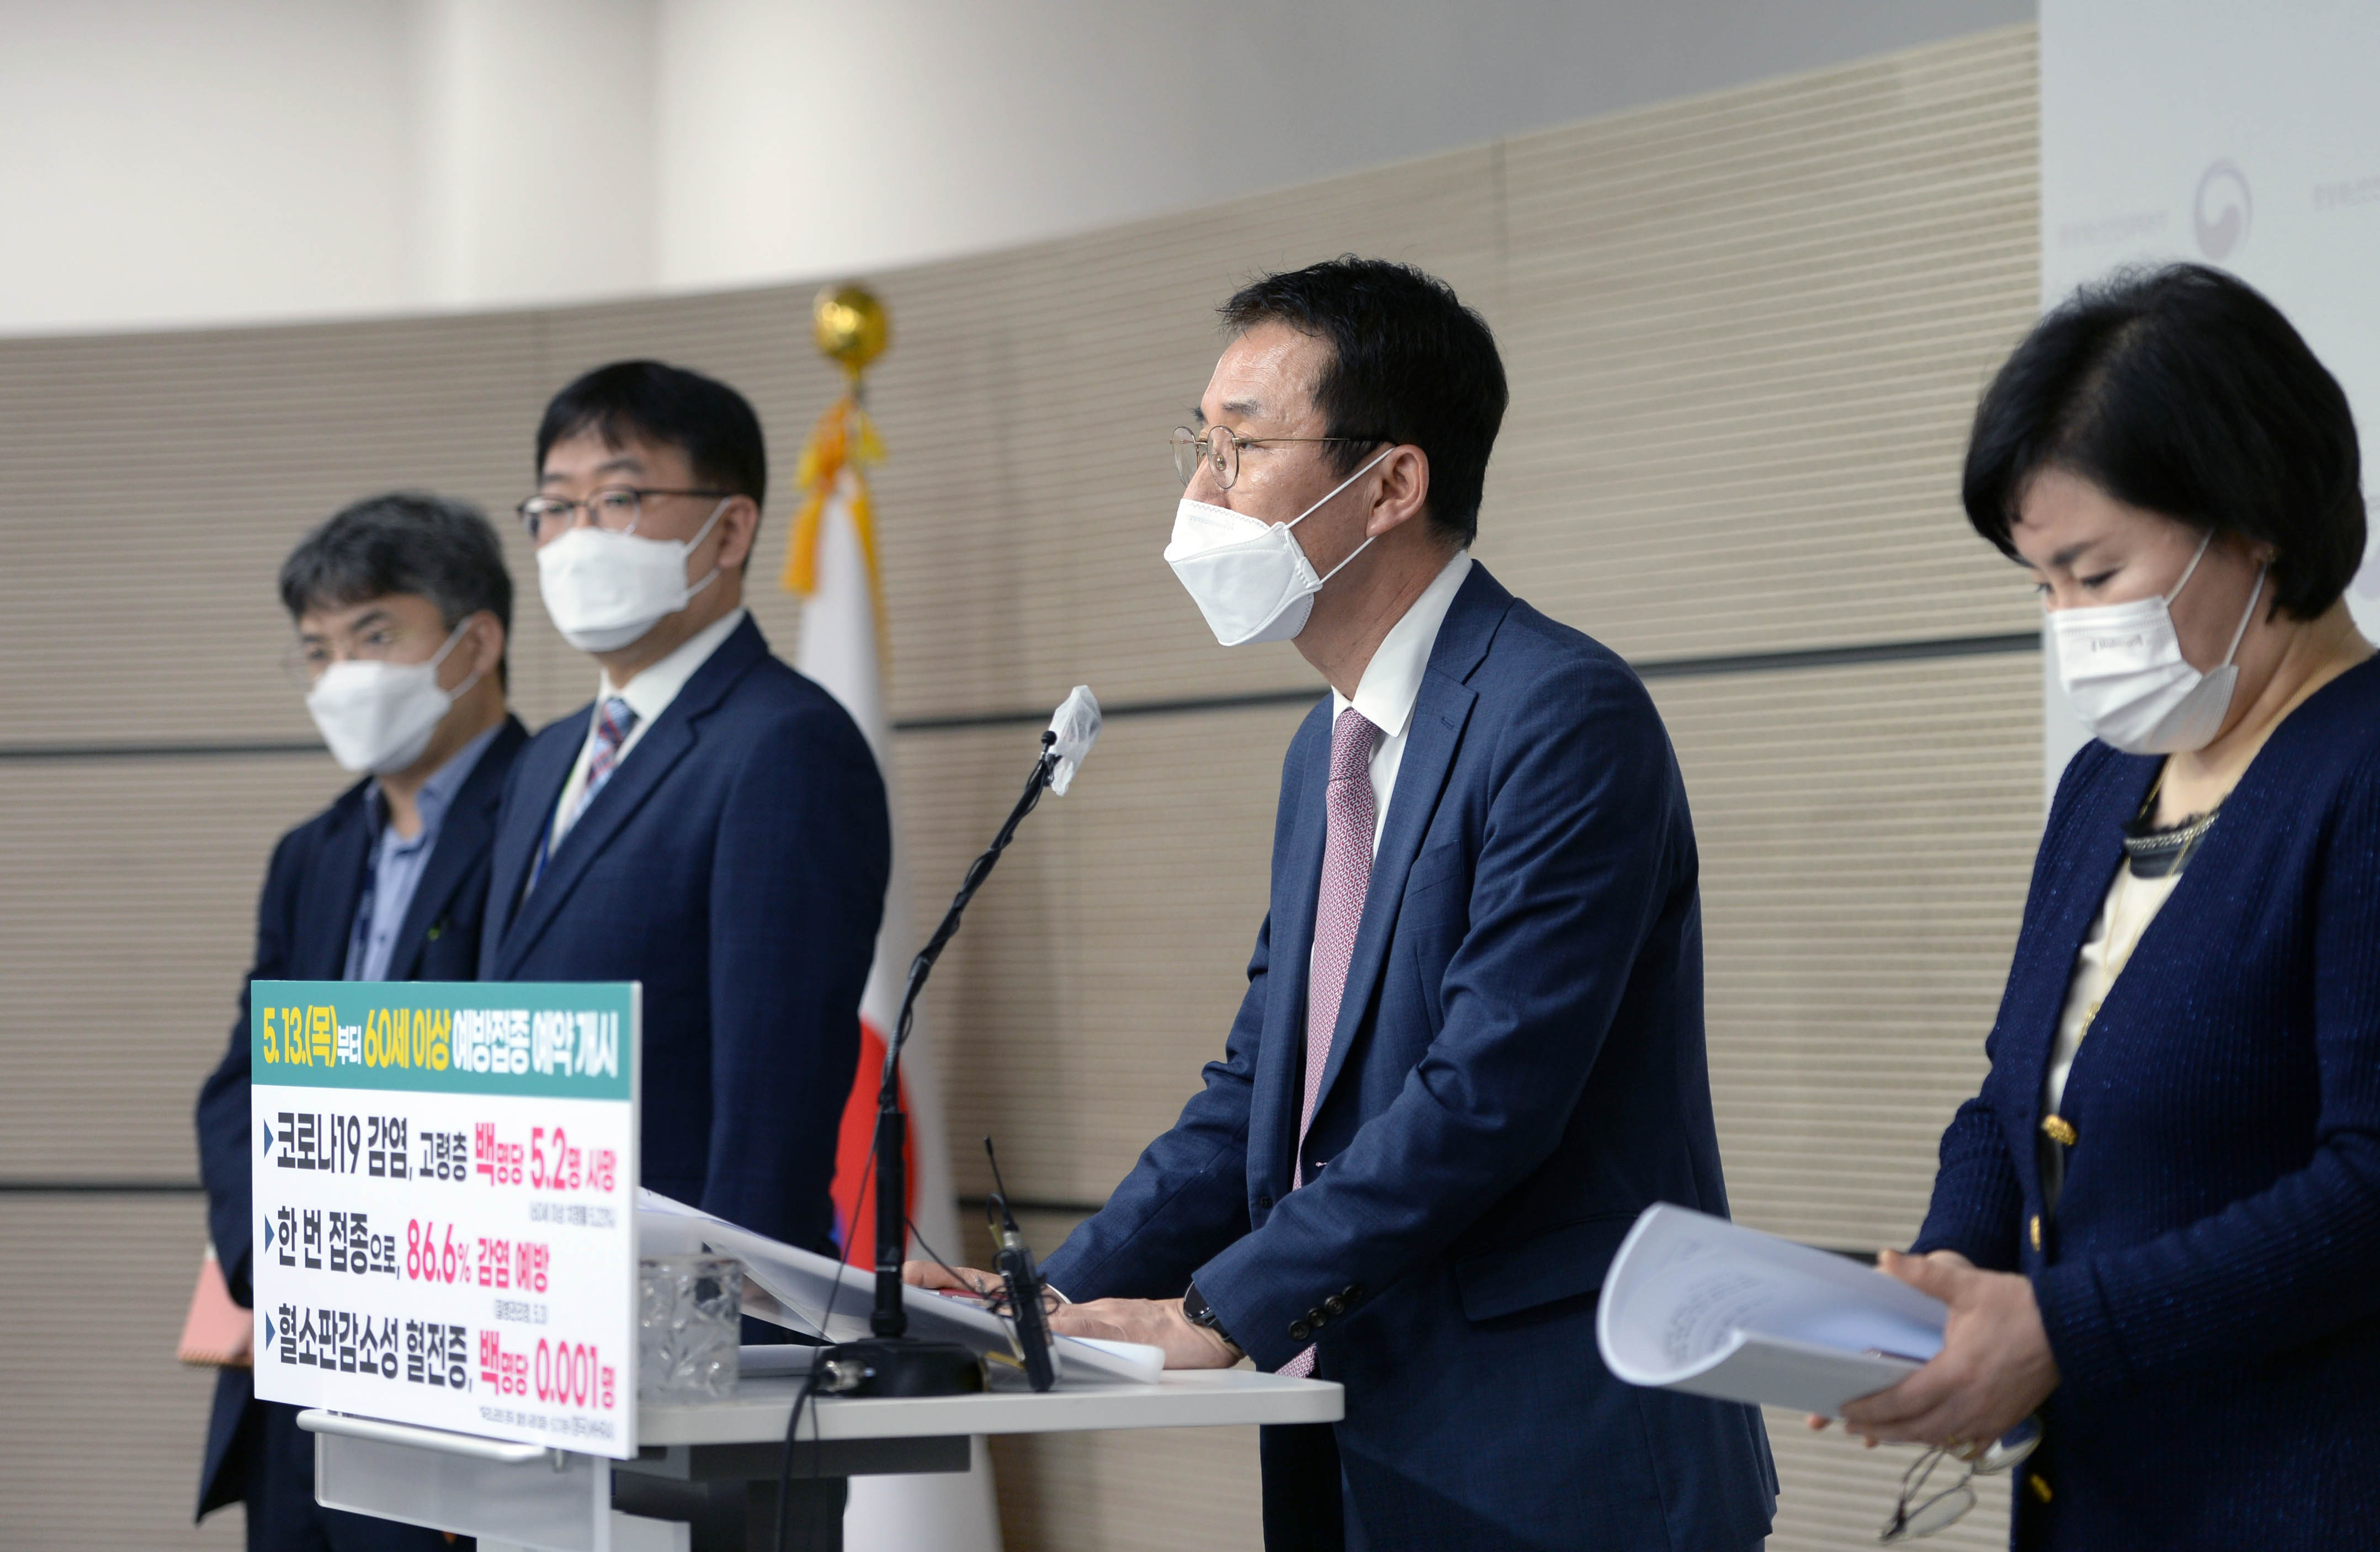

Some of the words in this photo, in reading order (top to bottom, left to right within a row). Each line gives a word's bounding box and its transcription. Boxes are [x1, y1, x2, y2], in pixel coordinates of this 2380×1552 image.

[263, 1004, 362, 1067] 5.13.(목)부터
[364, 1008, 410, 1069] 60세
[412, 1008, 452, 1071] 이상
[452, 1009, 531, 1075] 예방접종
[532, 1011, 575, 1076] 예약
[574, 1011, 618, 1077] 개시
[277, 1112, 360, 1174] 코로나19
[368, 1117, 412, 1181] 감염,
[419, 1130, 467, 1181] 고령층
[475, 1122, 524, 1186] 백명당
[530, 1126, 581, 1190] 5.2명
[587, 1150, 617, 1193] 사망
[278, 1205, 297, 1267] 한
[304, 1209, 322, 1269] 번
[329, 1211, 400, 1279] 접종으로,
[407, 1218, 471, 1284] 86.6%
[478, 1237, 510, 1289] 감염
[516, 1242, 550, 1293] 예방
[279, 1303, 398, 1379] 혈소판감소성
[406, 1319, 472, 1393] 혈전증,
[480, 1330, 529, 1397] 백명당
[535, 1337, 615, 1410] 0.001명
